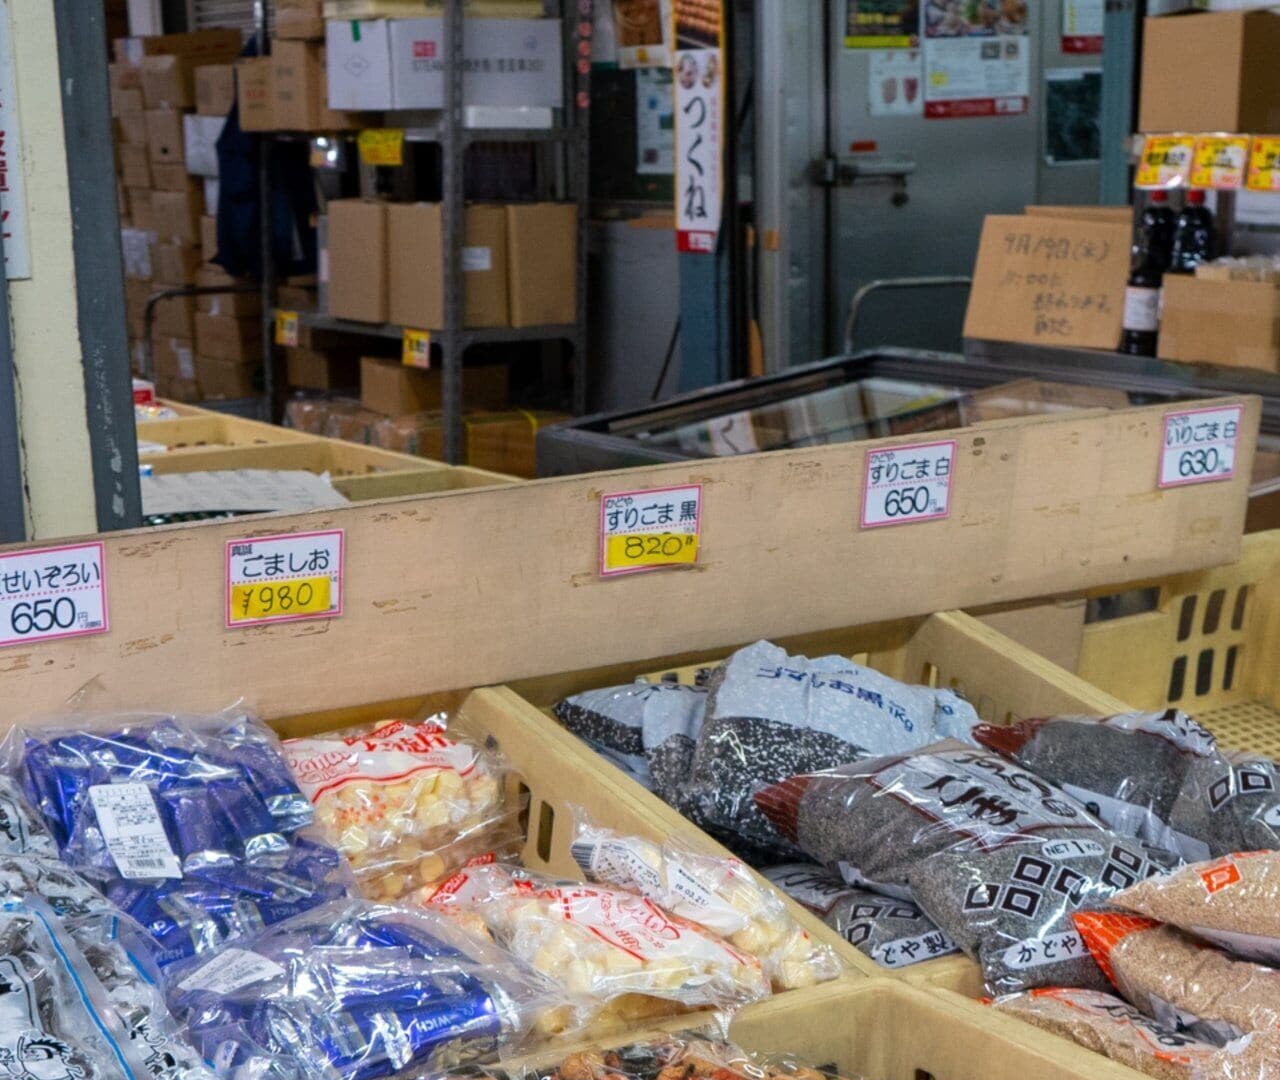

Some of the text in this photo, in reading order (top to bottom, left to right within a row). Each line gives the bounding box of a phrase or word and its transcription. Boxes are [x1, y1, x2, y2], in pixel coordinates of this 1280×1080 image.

[683, 96, 708, 223] つくね
[242, 548, 330, 578] ごましお
